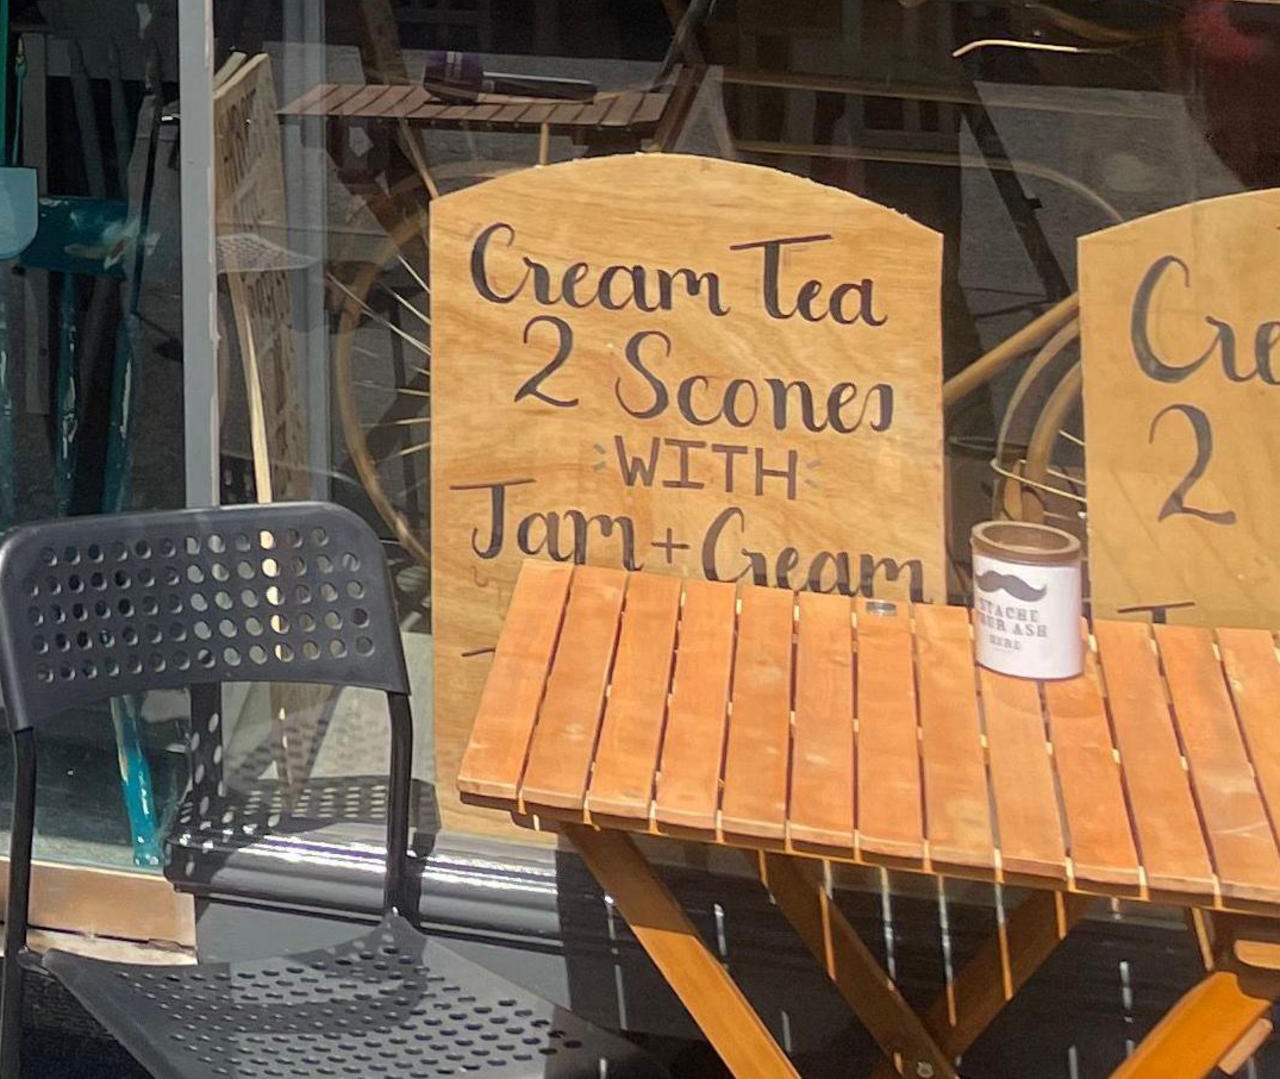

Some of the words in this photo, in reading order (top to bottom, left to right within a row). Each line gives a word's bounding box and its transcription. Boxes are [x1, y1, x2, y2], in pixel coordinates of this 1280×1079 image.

[470, 221, 732, 317] Cream
[728, 233, 888, 327] Tea
[513, 314, 580, 408] 2
[613, 330, 895, 434] Scones
[613, 434, 799, 501] WITH
[1148, 402, 1238, 526] 2
[1013, 623, 1049, 638] ASH
